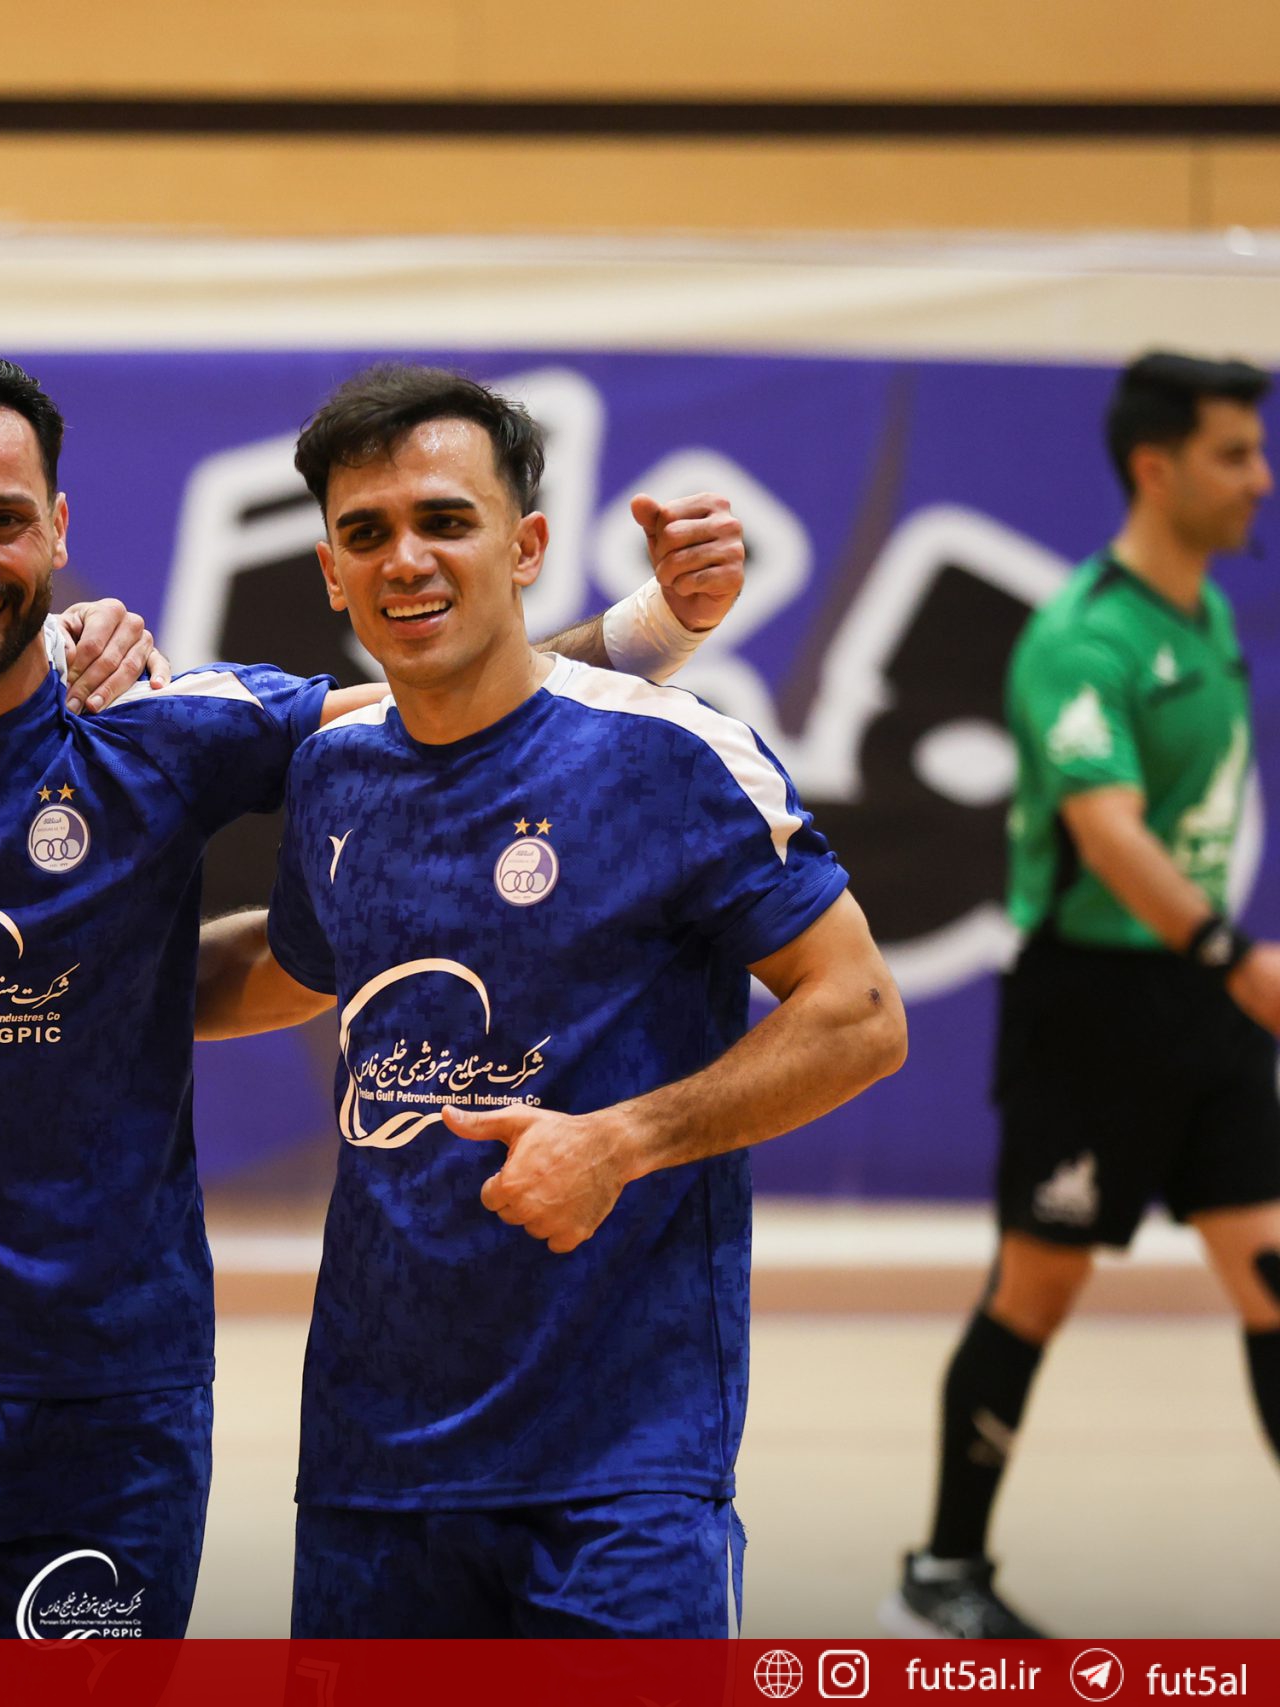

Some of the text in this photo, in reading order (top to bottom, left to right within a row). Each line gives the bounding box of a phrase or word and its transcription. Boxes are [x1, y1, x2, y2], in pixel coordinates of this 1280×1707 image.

[11, 962, 81, 1010] شرکت
[46, 1011, 61, 1022] Co
[353, 1052, 380, 1083] فارس
[375, 1038, 408, 1088] خلیج
[448, 1054, 494, 1091] صنایع
[487, 1035, 552, 1089] شرکت
[376, 1089, 395, 1102] Gulf
[525, 1094, 541, 1106] Co
